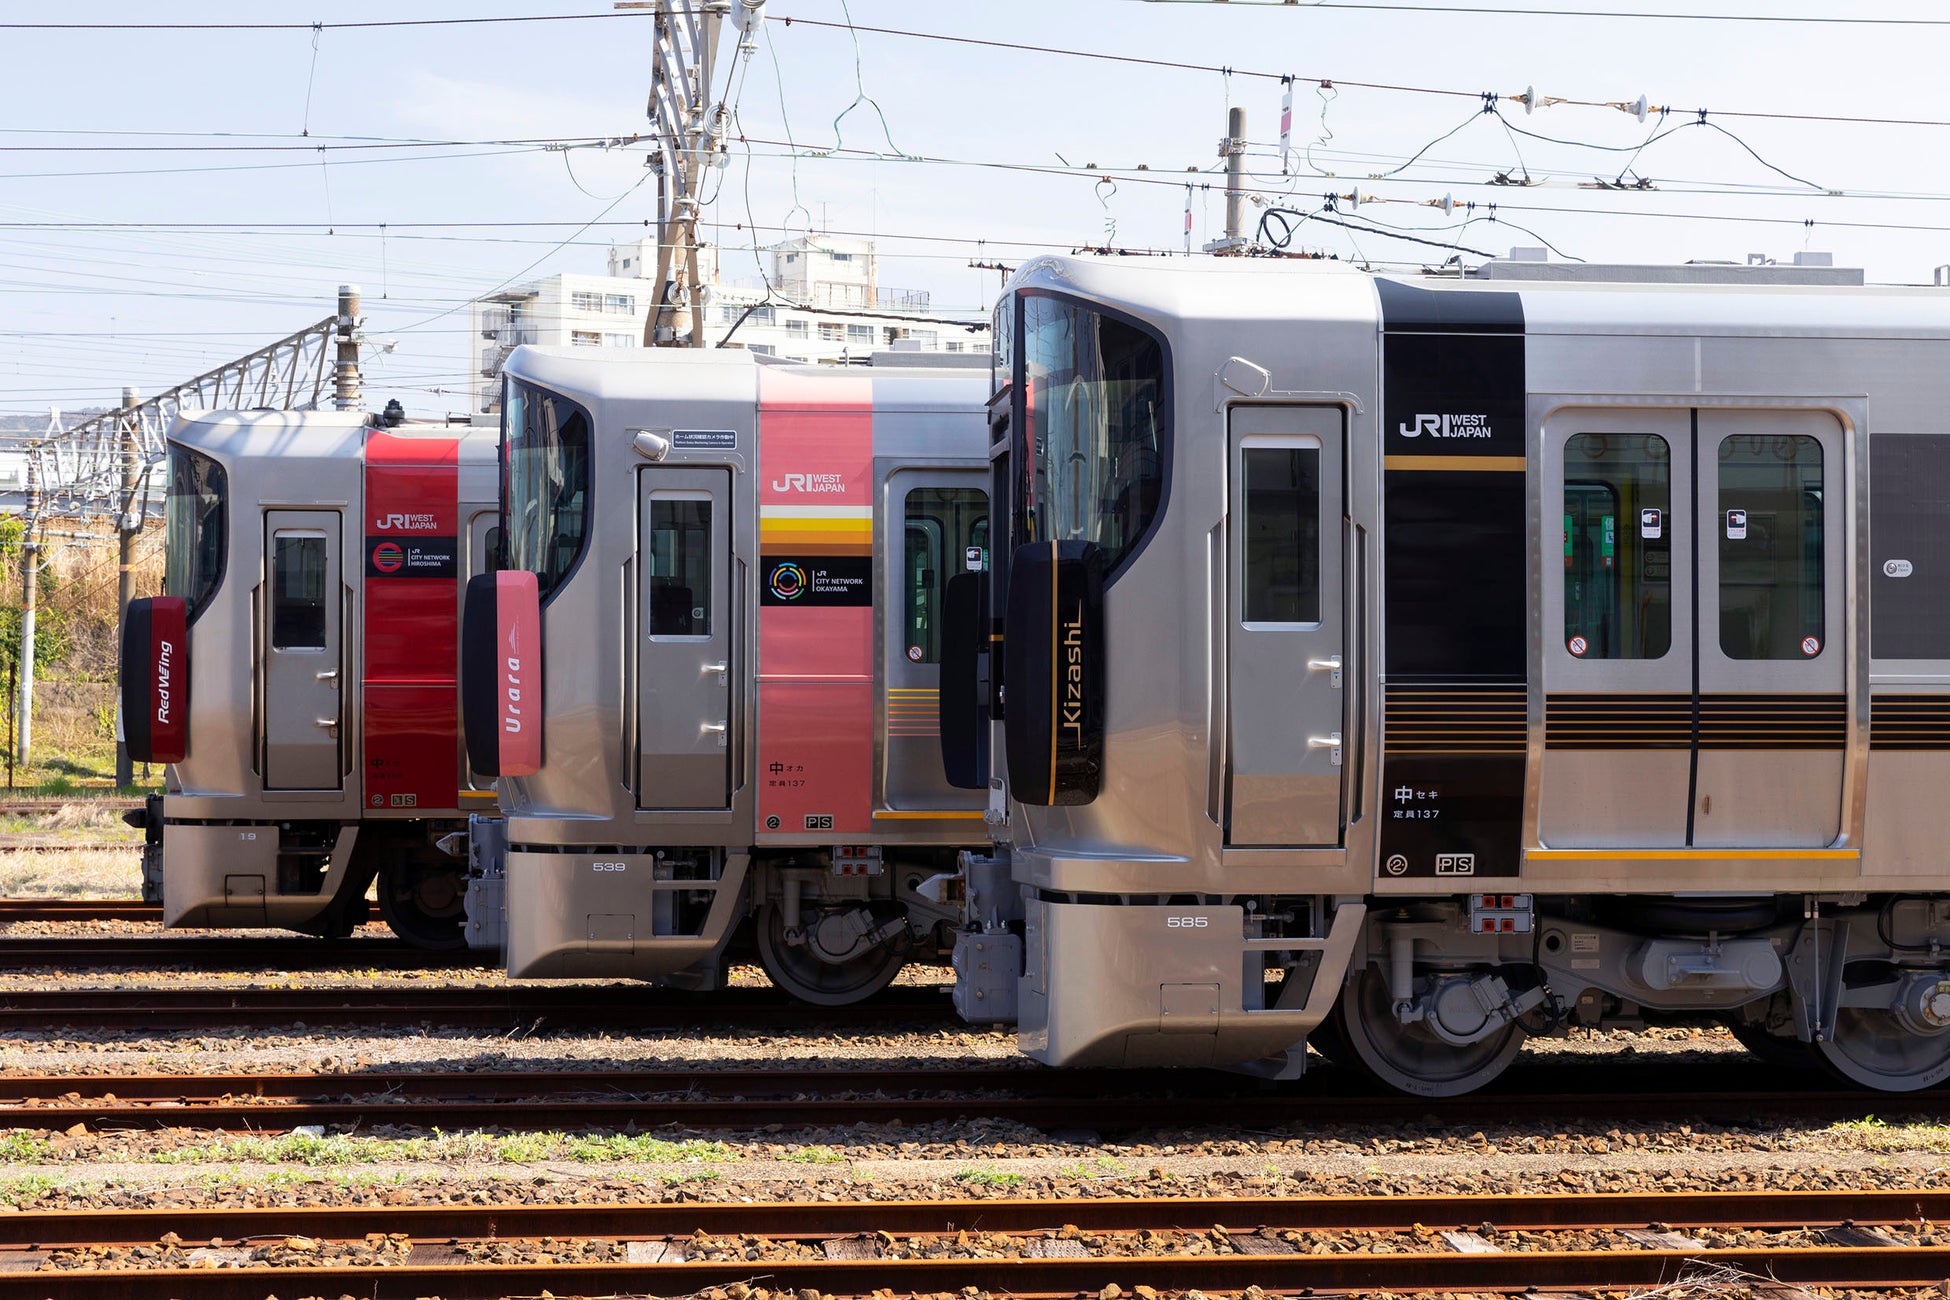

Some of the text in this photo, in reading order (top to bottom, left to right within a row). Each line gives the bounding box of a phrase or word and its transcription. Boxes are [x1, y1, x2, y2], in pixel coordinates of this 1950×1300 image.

[1400, 414, 1441, 438] JR
[1450, 415, 1487, 426] WEST
[1450, 426, 1492, 438] JAPAN
[773, 474, 805, 492] JR
[813, 474, 842, 483] WEST
[813, 484, 845, 492] JAPAN
[376, 514, 404, 529] JR
[1063, 599, 1082, 751] Kizashi
[506, 657, 521, 733] Urara
[240, 833, 256, 841] 19
[593, 862, 626, 872] 539
[1167, 916, 1208, 928] 585
